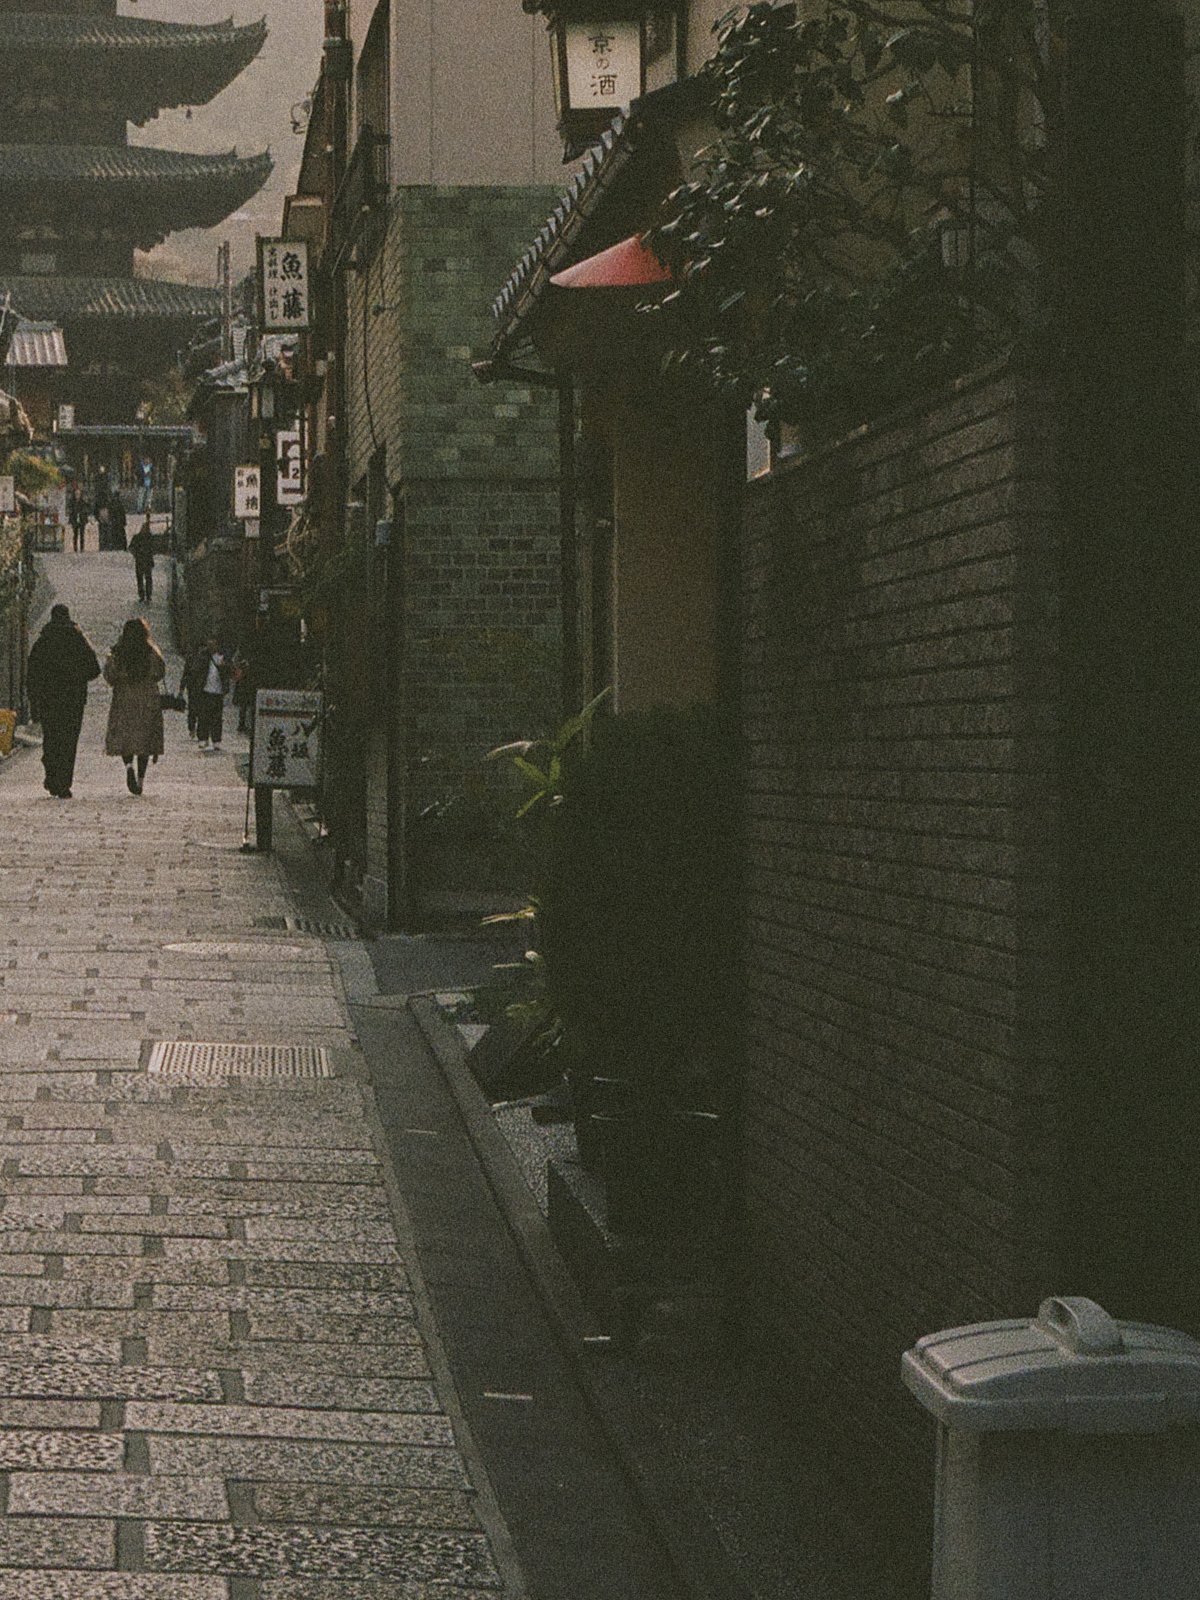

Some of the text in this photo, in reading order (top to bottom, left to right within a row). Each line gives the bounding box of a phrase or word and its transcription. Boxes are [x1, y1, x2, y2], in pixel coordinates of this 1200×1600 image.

[588, 33, 618, 96] 京の酒
[280, 251, 305, 320] 魚藤
